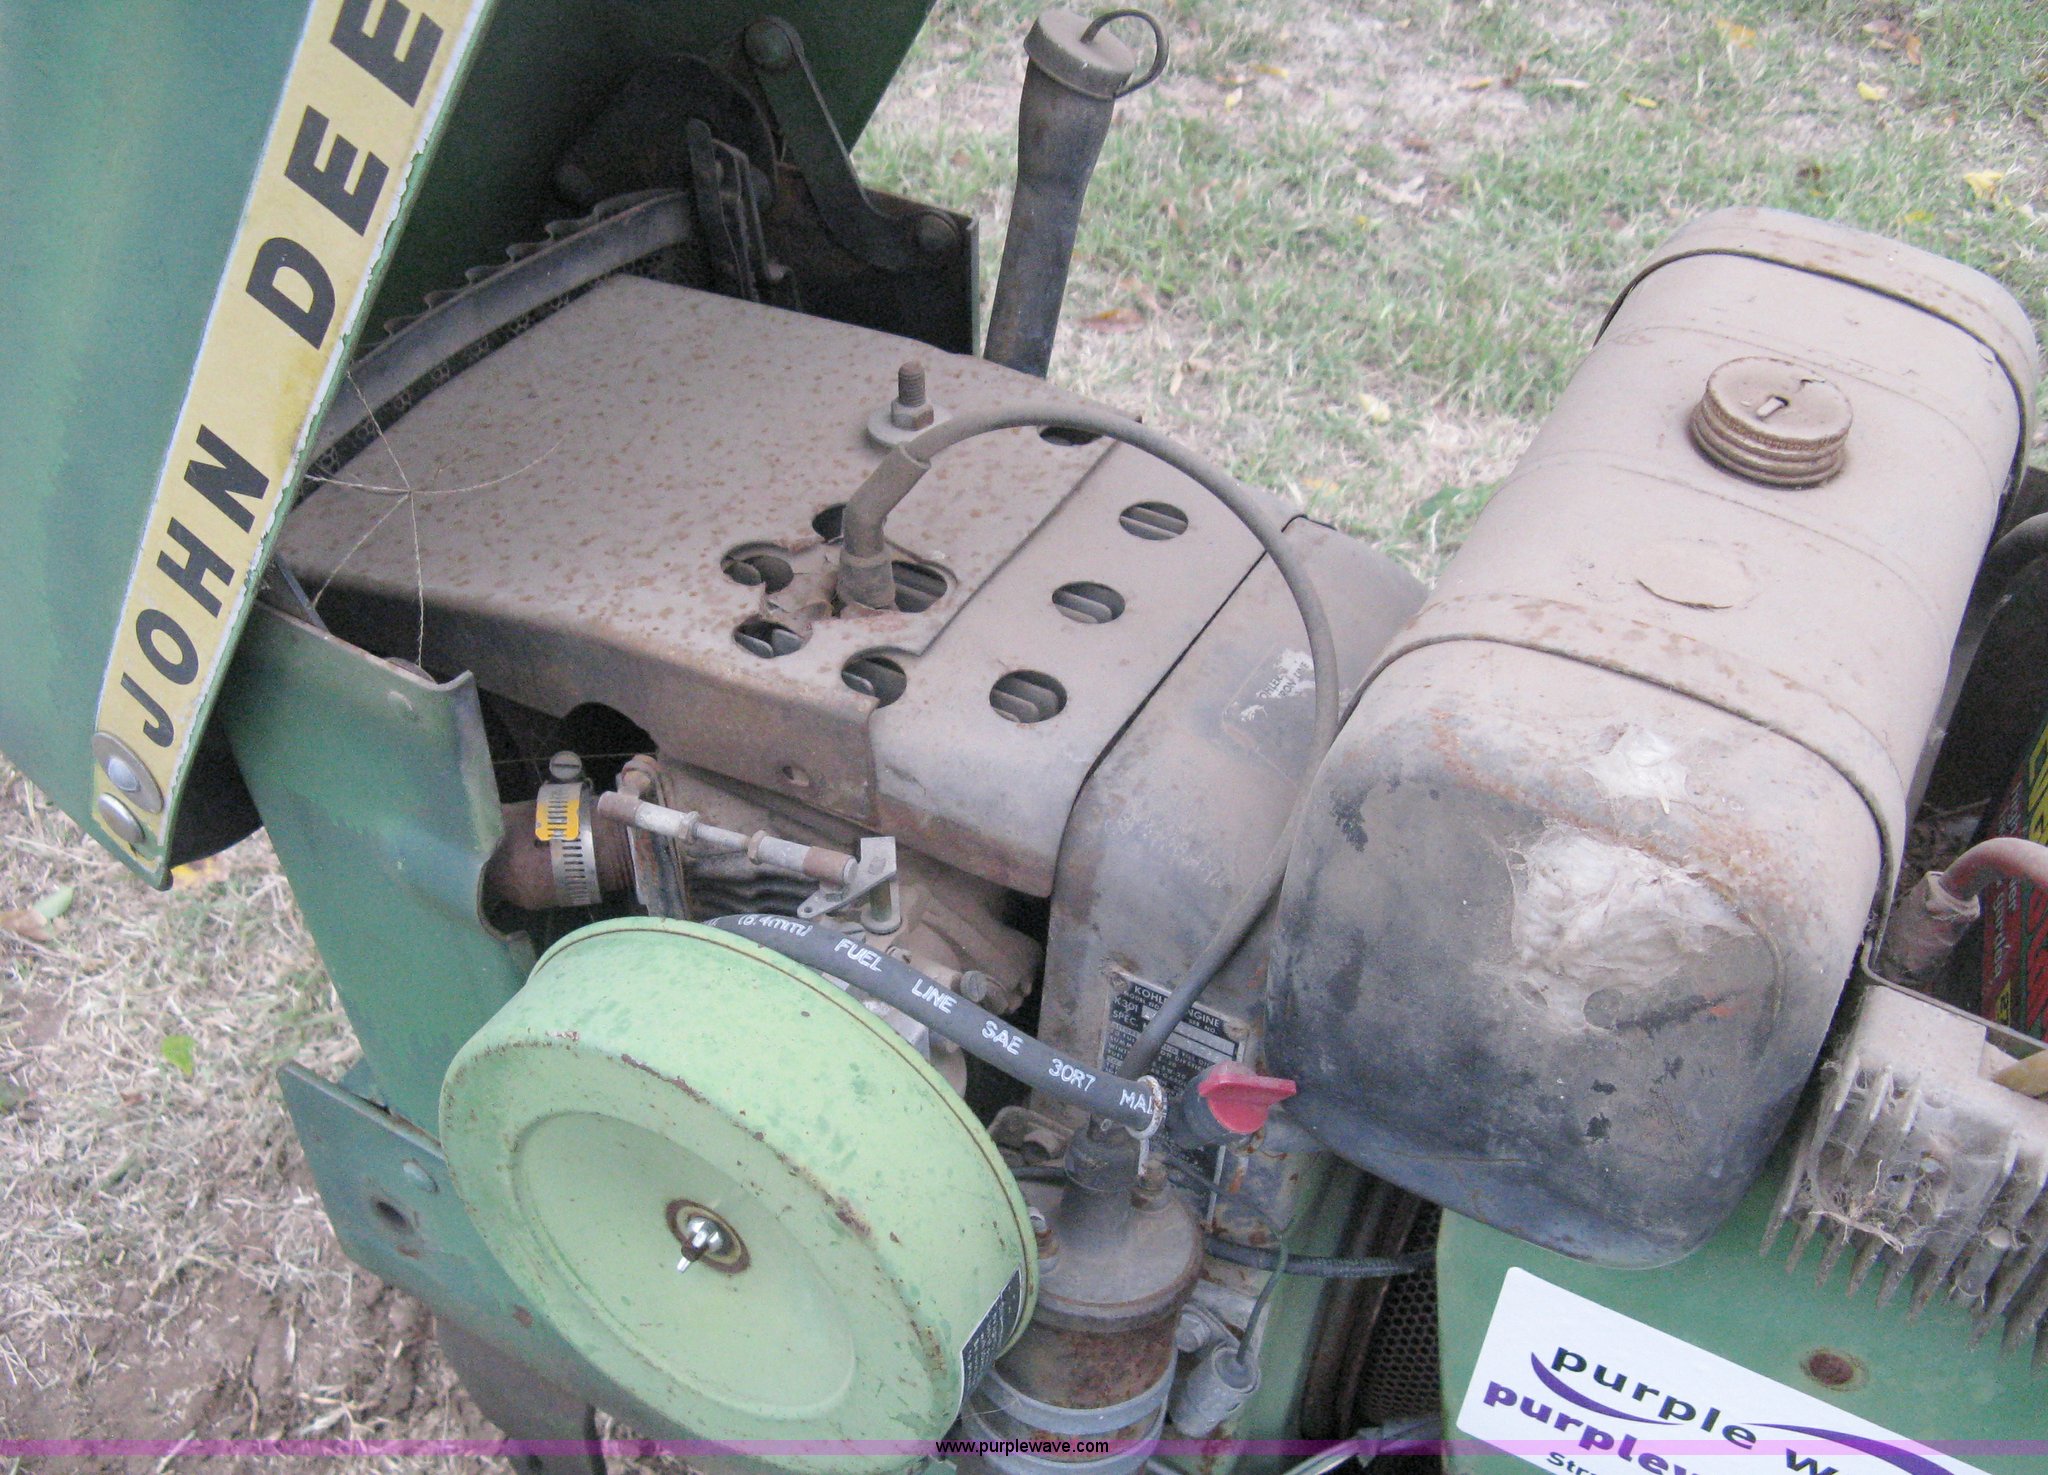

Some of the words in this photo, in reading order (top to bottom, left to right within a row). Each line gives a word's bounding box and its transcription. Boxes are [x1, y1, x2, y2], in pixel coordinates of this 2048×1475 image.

[102, 424, 270, 749] JOHN
[834, 937, 884, 973] FUEL
[911, 978, 959, 1015] LINE
[981, 1020, 1025, 1056] SAE
[1048, 1058, 1097, 1092] 30R7
[1187, 1009, 1221, 1028] NGINE
[1551, 1346, 1757, 1450] purple
[1547, 1451, 1597, 1475] Str
